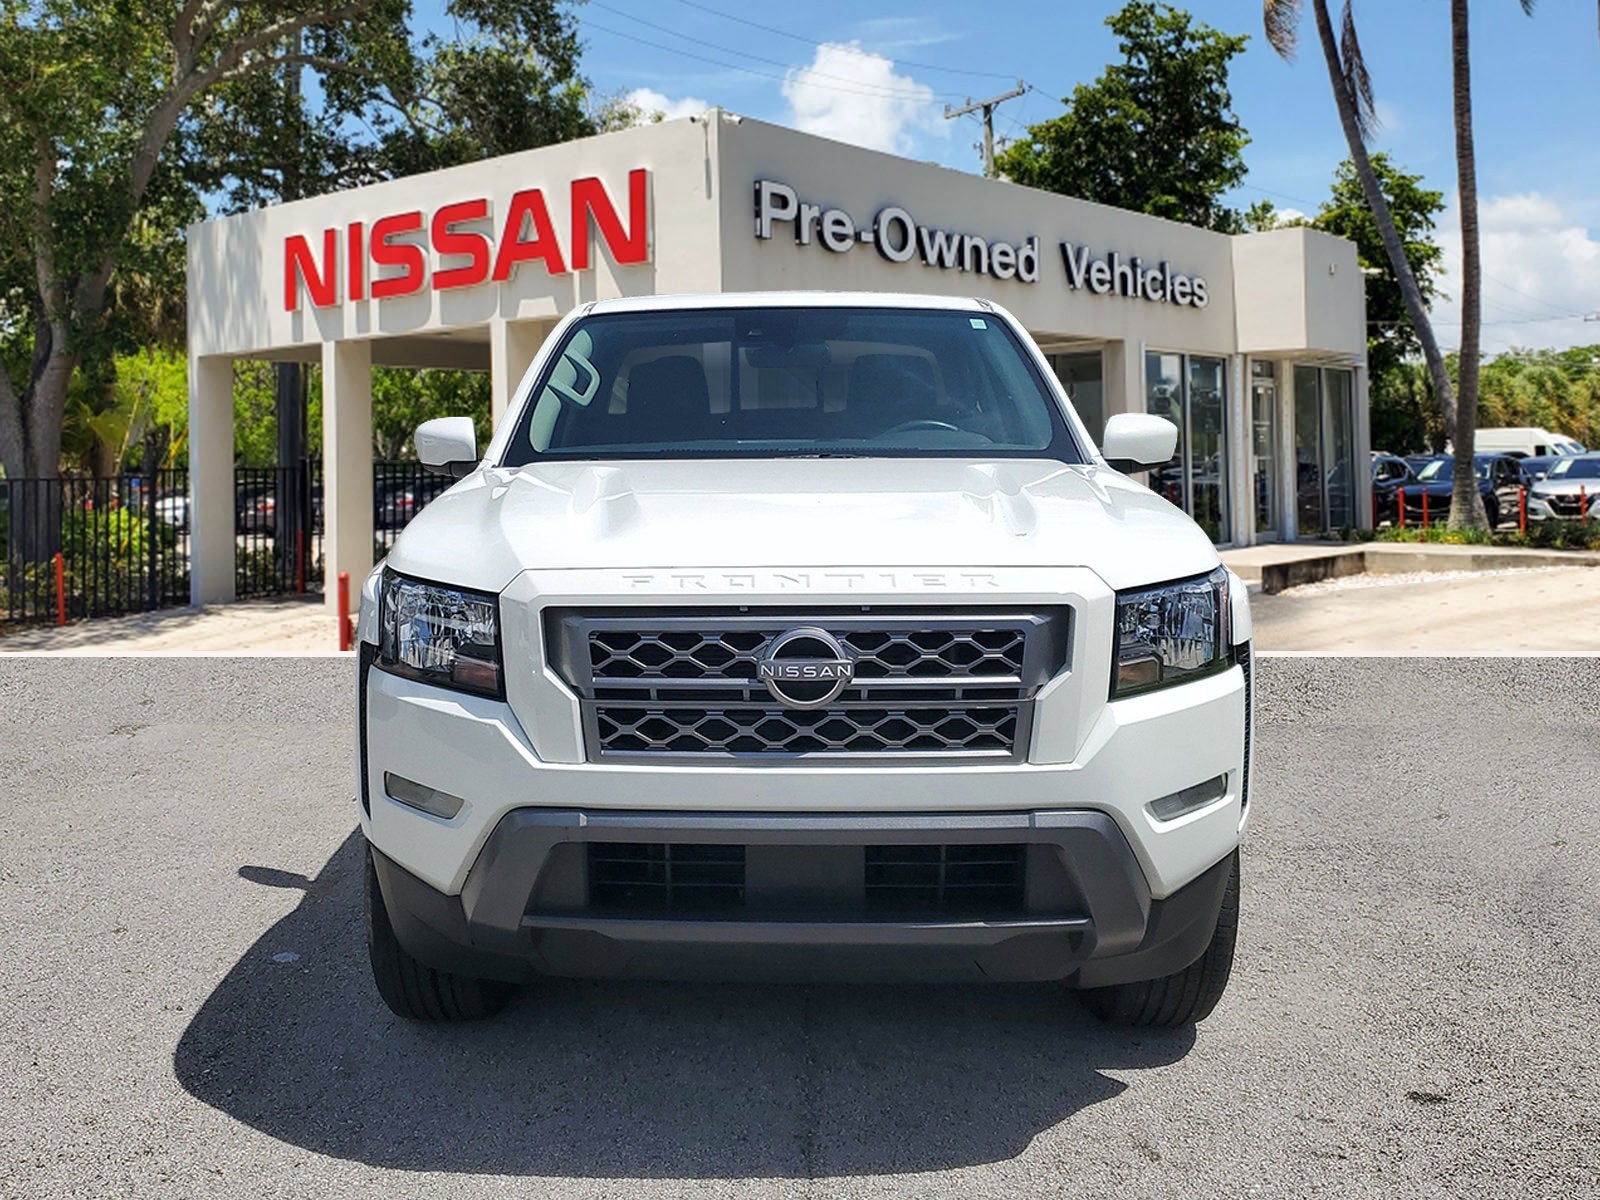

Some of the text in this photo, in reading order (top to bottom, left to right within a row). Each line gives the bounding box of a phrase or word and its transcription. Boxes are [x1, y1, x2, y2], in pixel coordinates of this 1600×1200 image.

[284, 168, 648, 311] NISSAN
[754, 180, 1208, 308] Pre-Owned Vehicles
[622, 574, 1001, 589] FRONTIER
[759, 663, 852, 679] NISSAN
